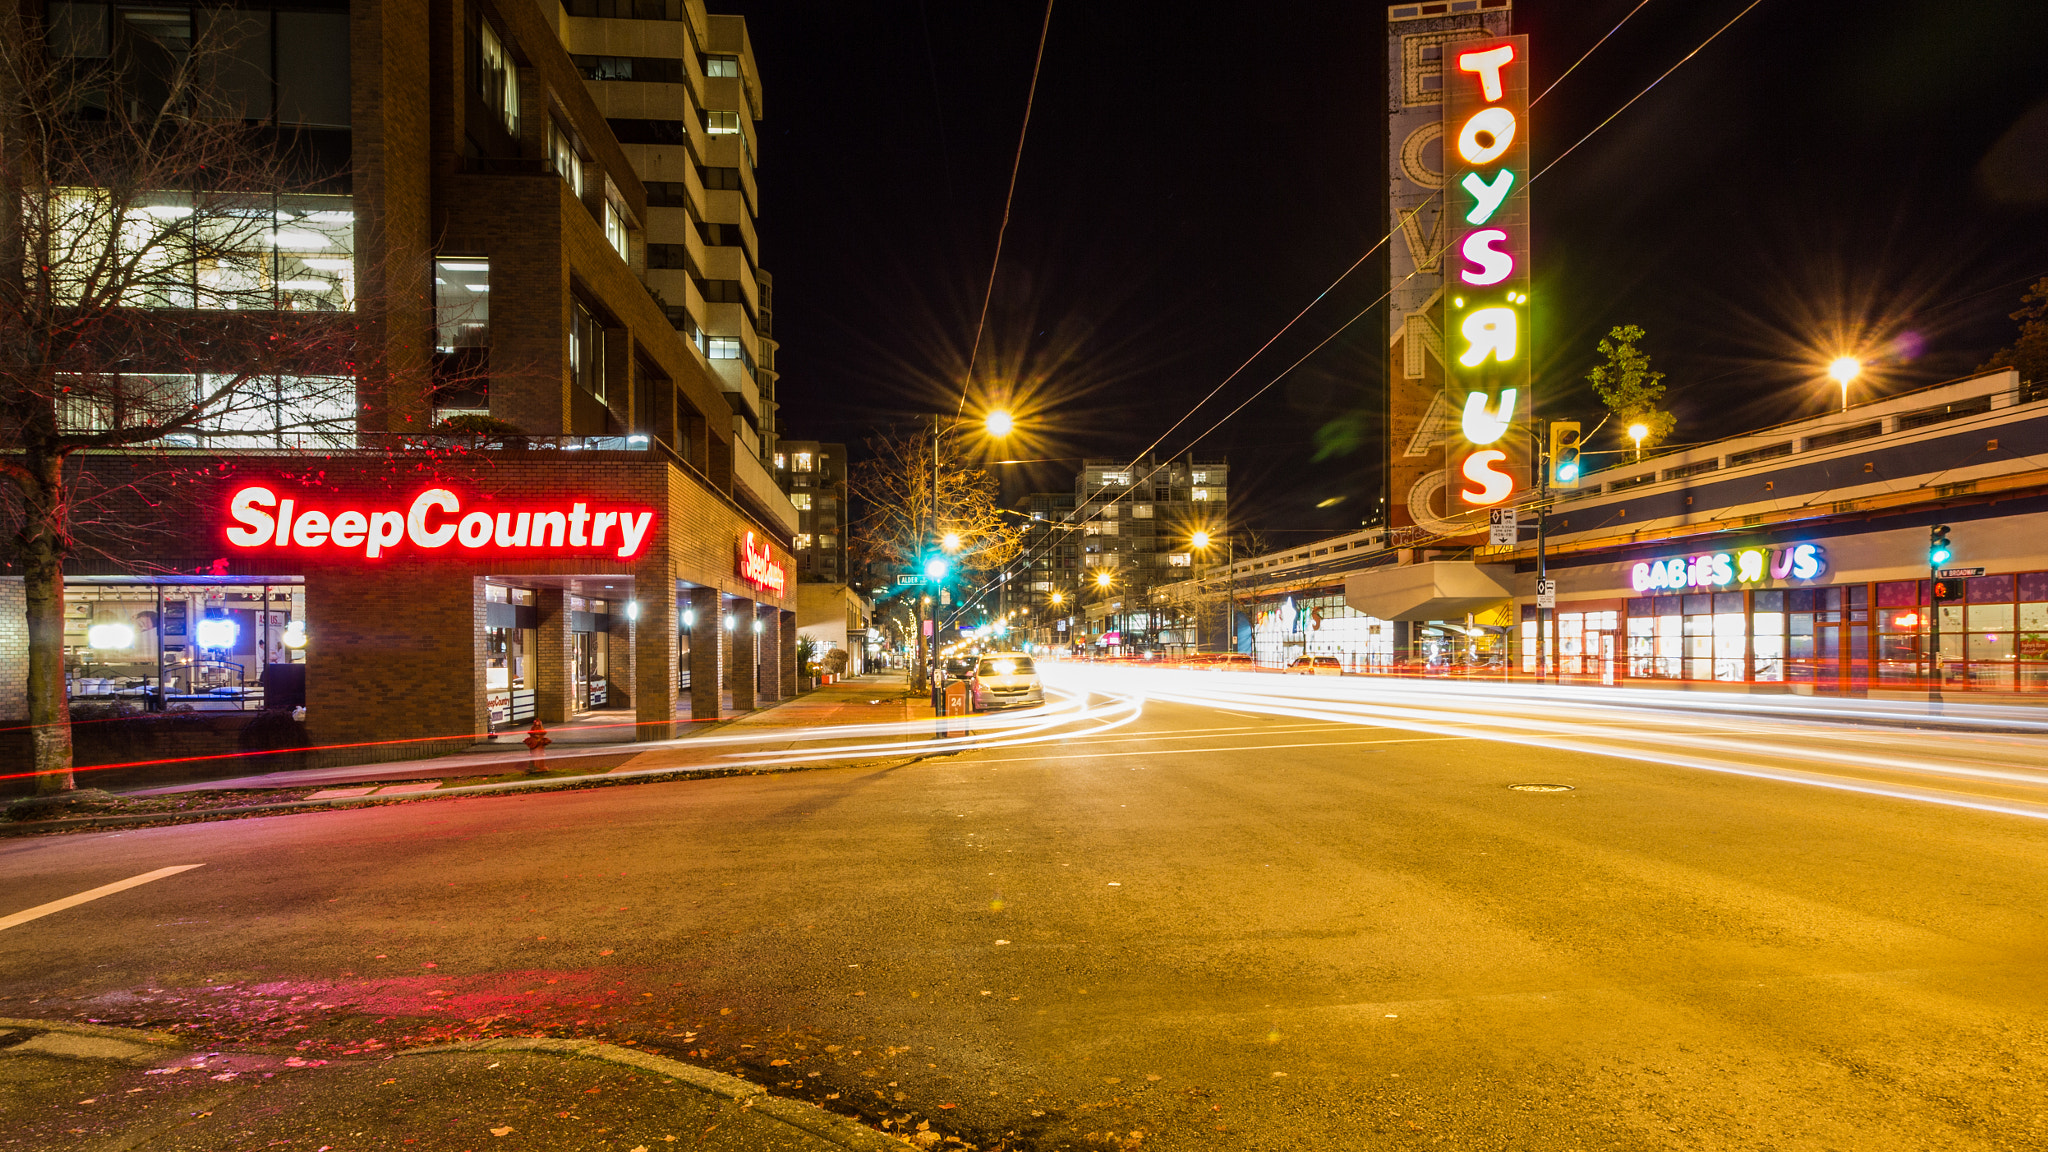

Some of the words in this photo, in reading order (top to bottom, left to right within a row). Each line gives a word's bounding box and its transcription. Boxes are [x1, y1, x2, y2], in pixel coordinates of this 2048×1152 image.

[1458, 44, 1515, 286] TOYS
[1461, 388, 1518, 505] US
[226, 486, 652, 558] SleepCountry
[901, 576, 918, 584] ALDER
[1770, 544, 1820, 580] US
[951, 697, 962, 707] 24
